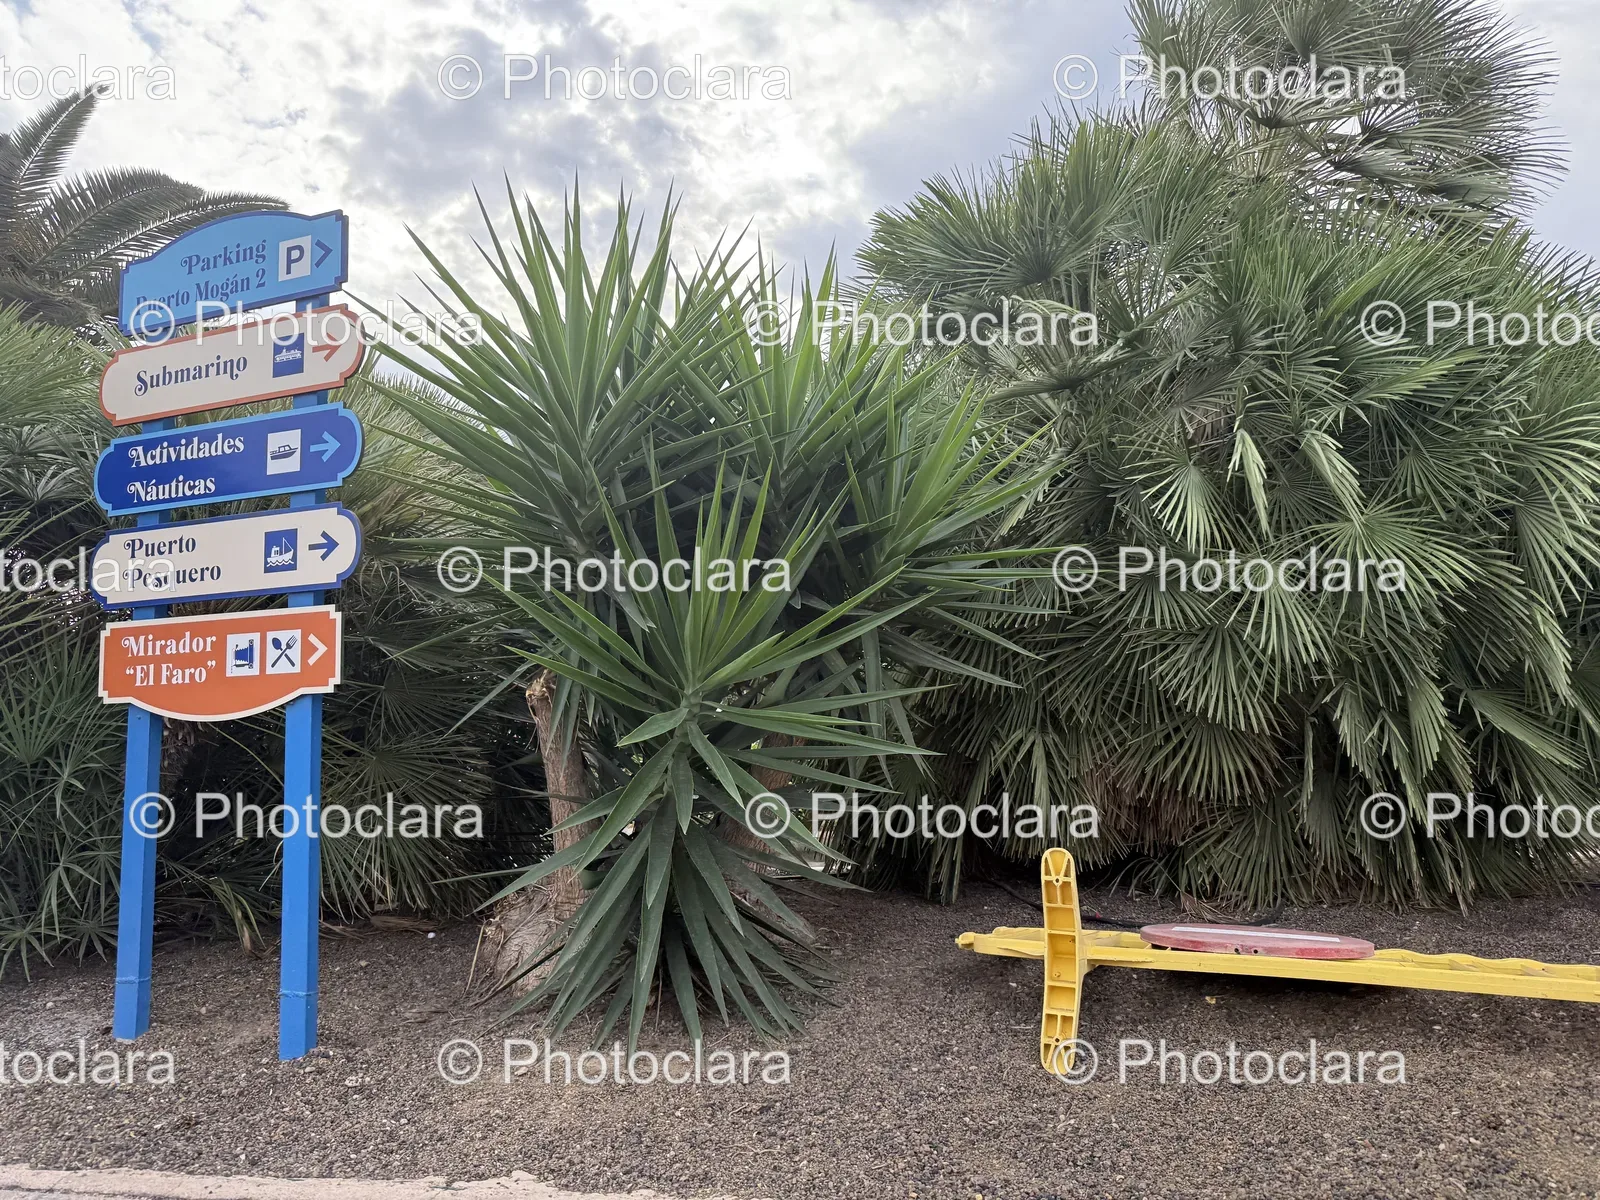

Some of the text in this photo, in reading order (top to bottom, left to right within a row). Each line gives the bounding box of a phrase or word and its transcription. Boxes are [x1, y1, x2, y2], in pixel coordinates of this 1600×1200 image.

[180, 239, 267, 276] Parking
[285, 244, 305, 276] P
[135, 267, 266, 316] Puerto Mogán 2
[134, 354, 248, 397] Submarino
[128, 432, 245, 468] Actividades
[127, 474, 216, 503] Náuticas
[123, 534, 197, 559] Puerto
[121, 631, 217, 657] Mirador
